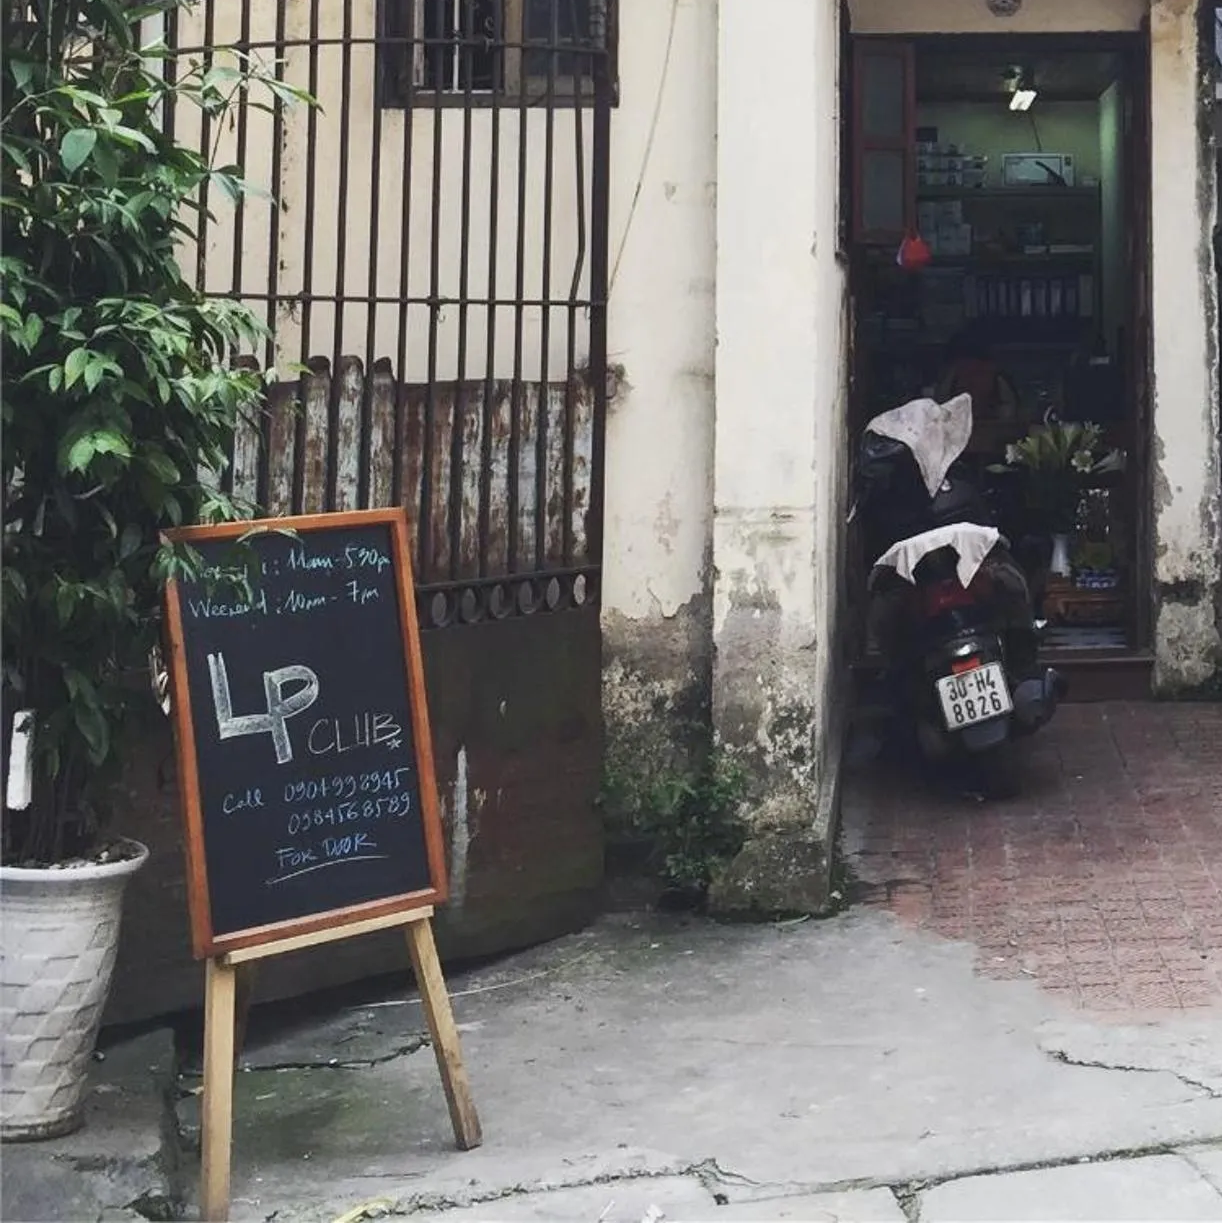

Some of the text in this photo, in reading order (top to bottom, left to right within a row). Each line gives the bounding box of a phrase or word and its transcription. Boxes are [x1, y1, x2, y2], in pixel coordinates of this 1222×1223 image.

[207, 652, 319, 764] LP
[953, 691, 1001, 723] 8826
[308, 712, 401, 755] CLUB
[223, 788, 265, 815] Call
